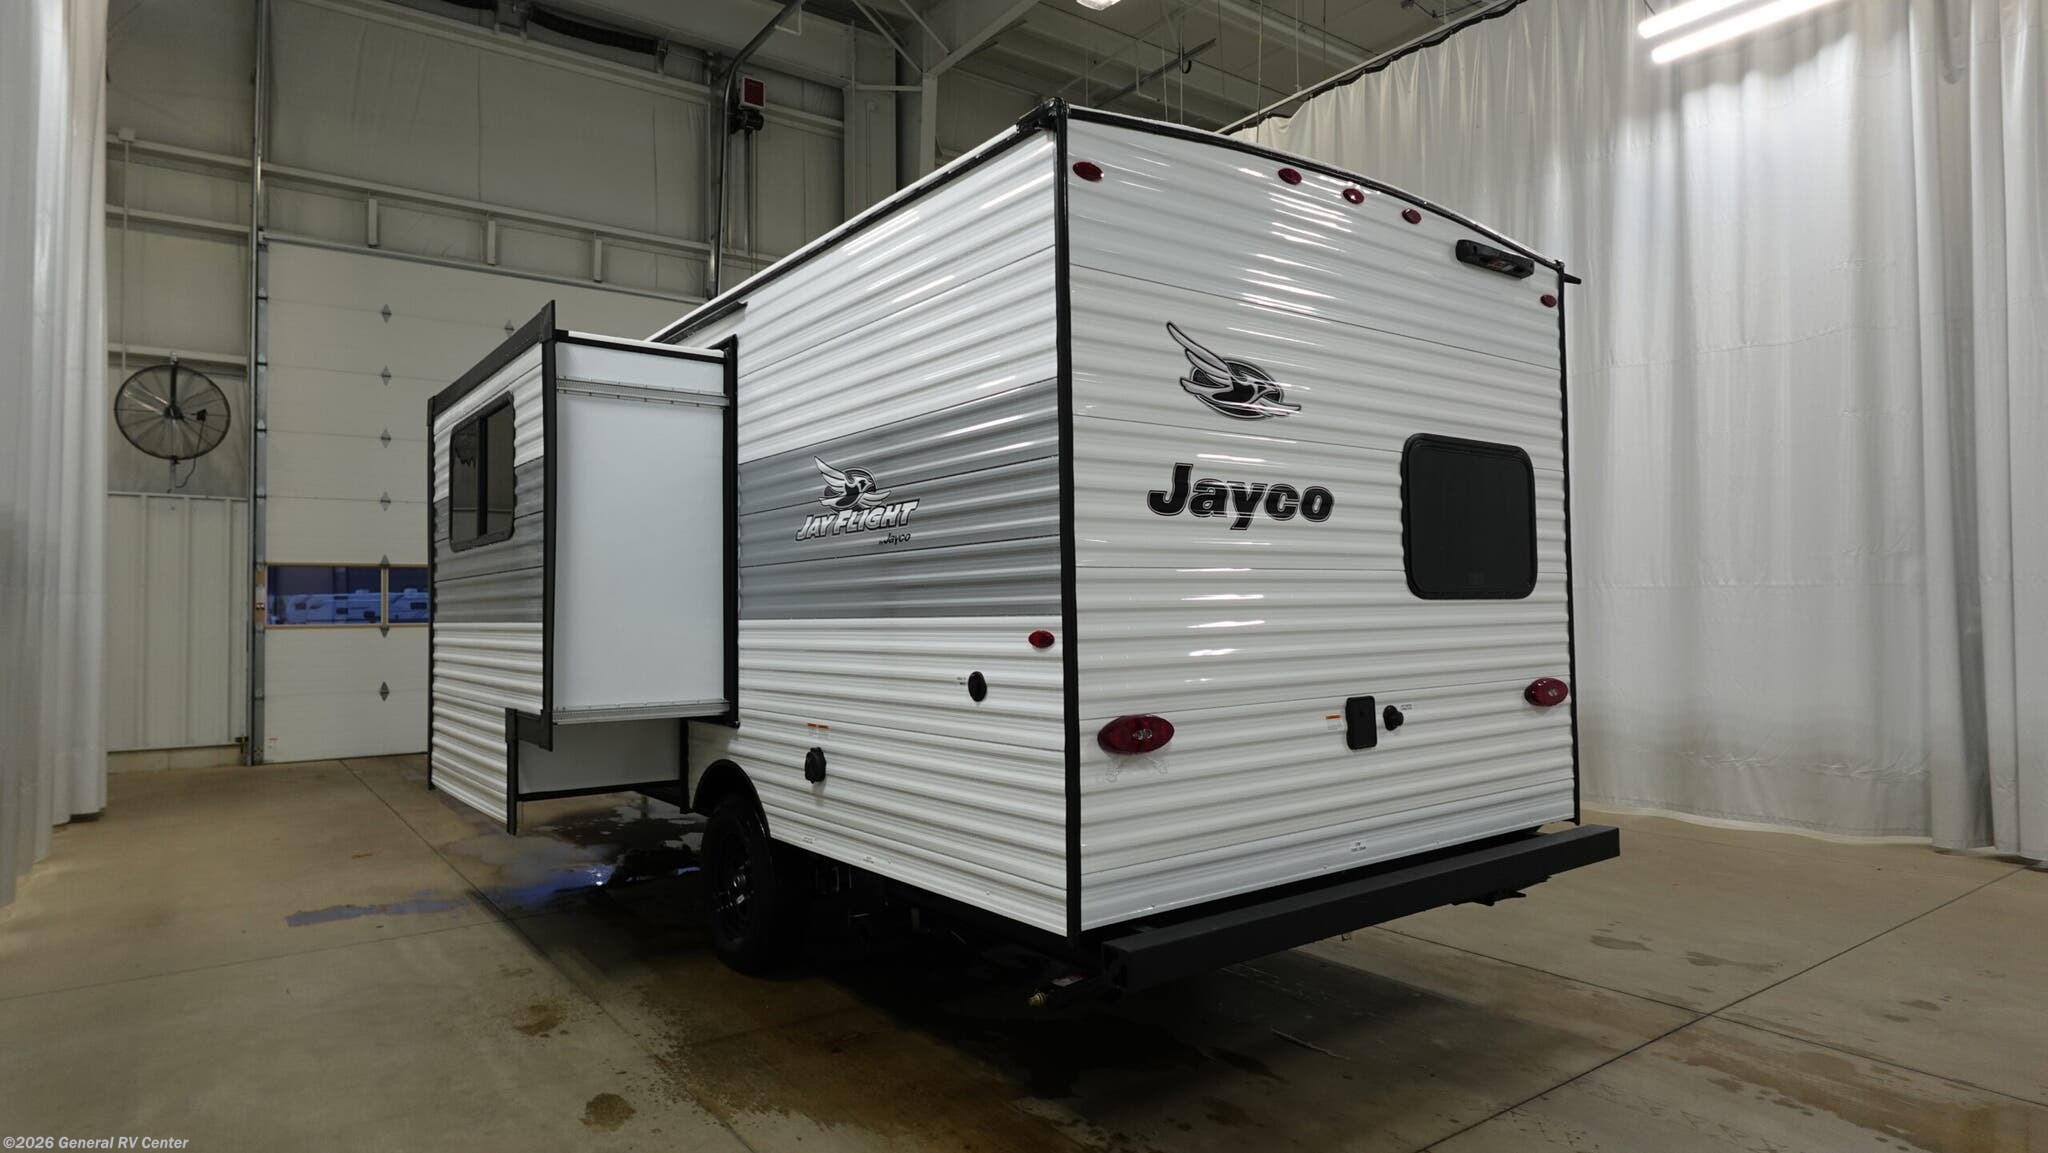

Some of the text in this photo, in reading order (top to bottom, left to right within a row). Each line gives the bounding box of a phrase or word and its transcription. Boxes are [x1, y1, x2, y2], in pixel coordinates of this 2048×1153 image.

[1147, 462, 1335, 531] Jayco
[796, 500, 920, 541] JAY FLIGHT
[884, 533, 911, 545] Jayco
